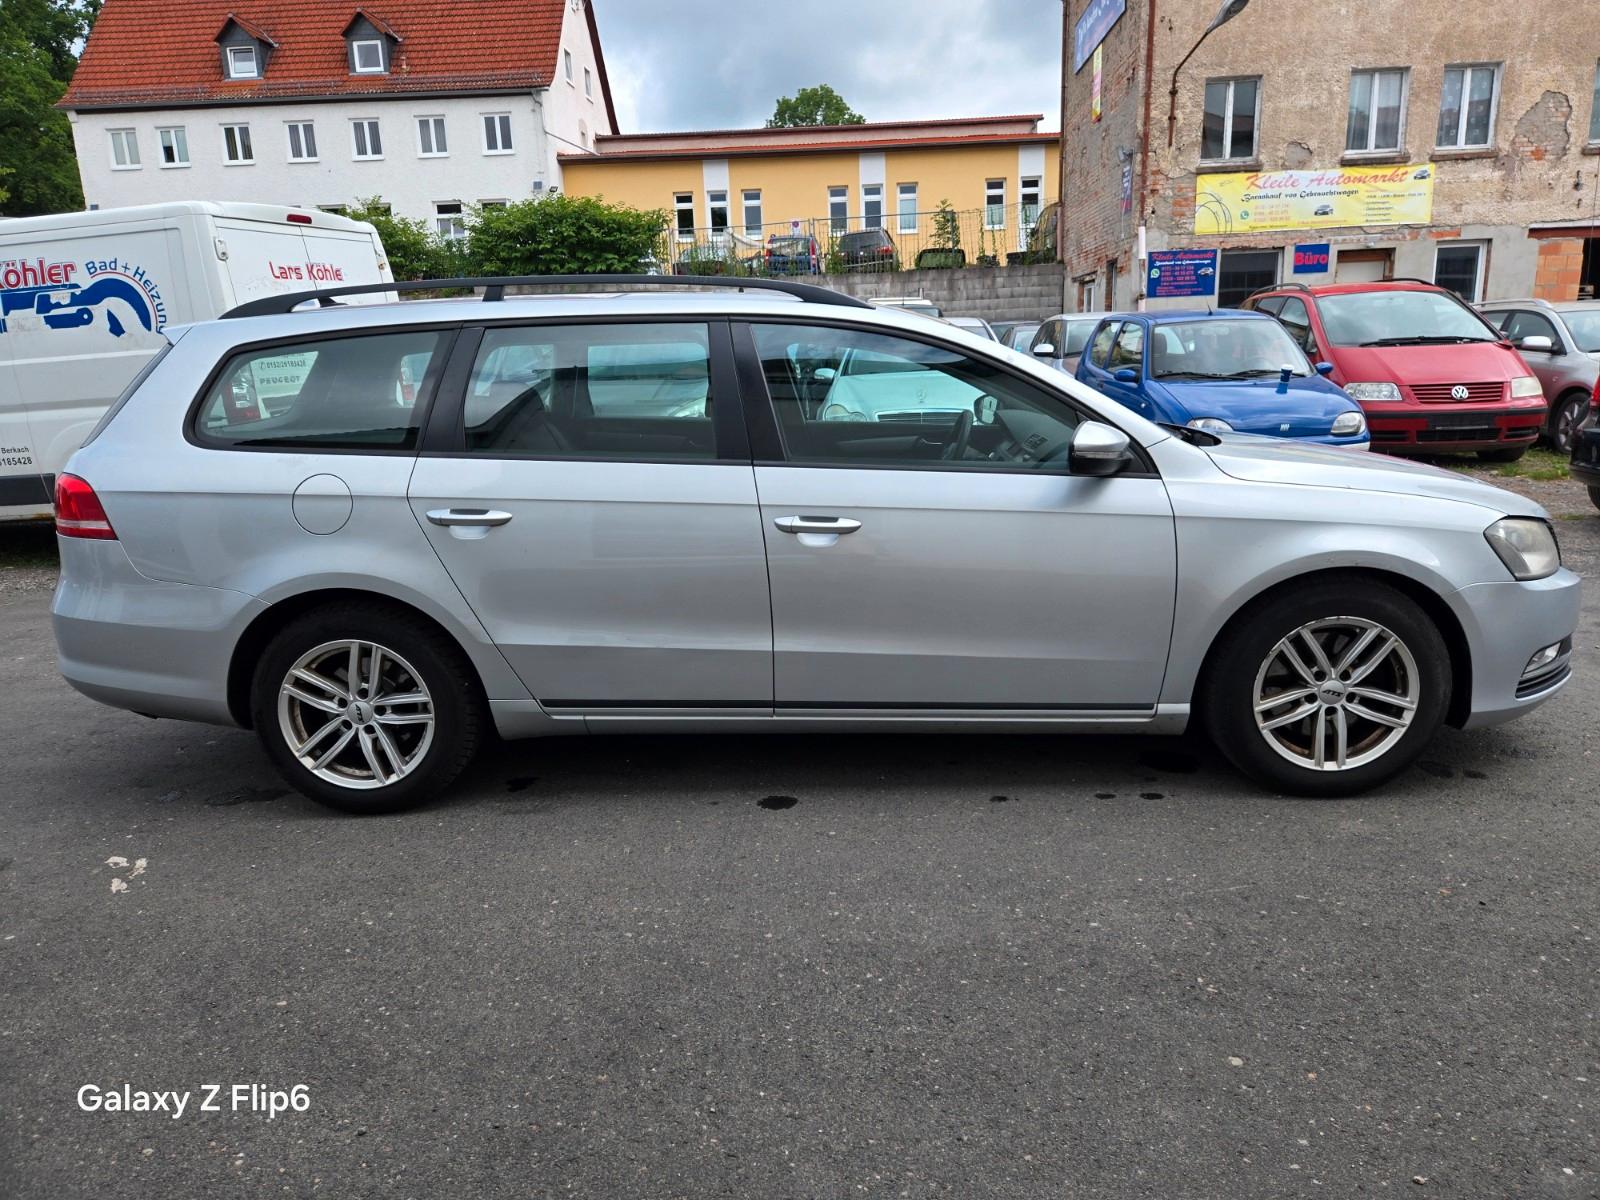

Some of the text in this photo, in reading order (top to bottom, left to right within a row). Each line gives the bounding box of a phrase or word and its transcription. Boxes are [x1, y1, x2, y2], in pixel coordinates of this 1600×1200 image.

[1246, 166, 1408, 190] Kleile Automarkt
[1299, 189, 1358, 198] Gebrauchtwagen
[1295, 252, 1328, 265] Büro
[86, 258, 117, 276] Bad
[269, 261, 303, 280] Lars
[260, 375, 301, 385] PEUGEOT
[1, 446, 30, 454] Berkach
